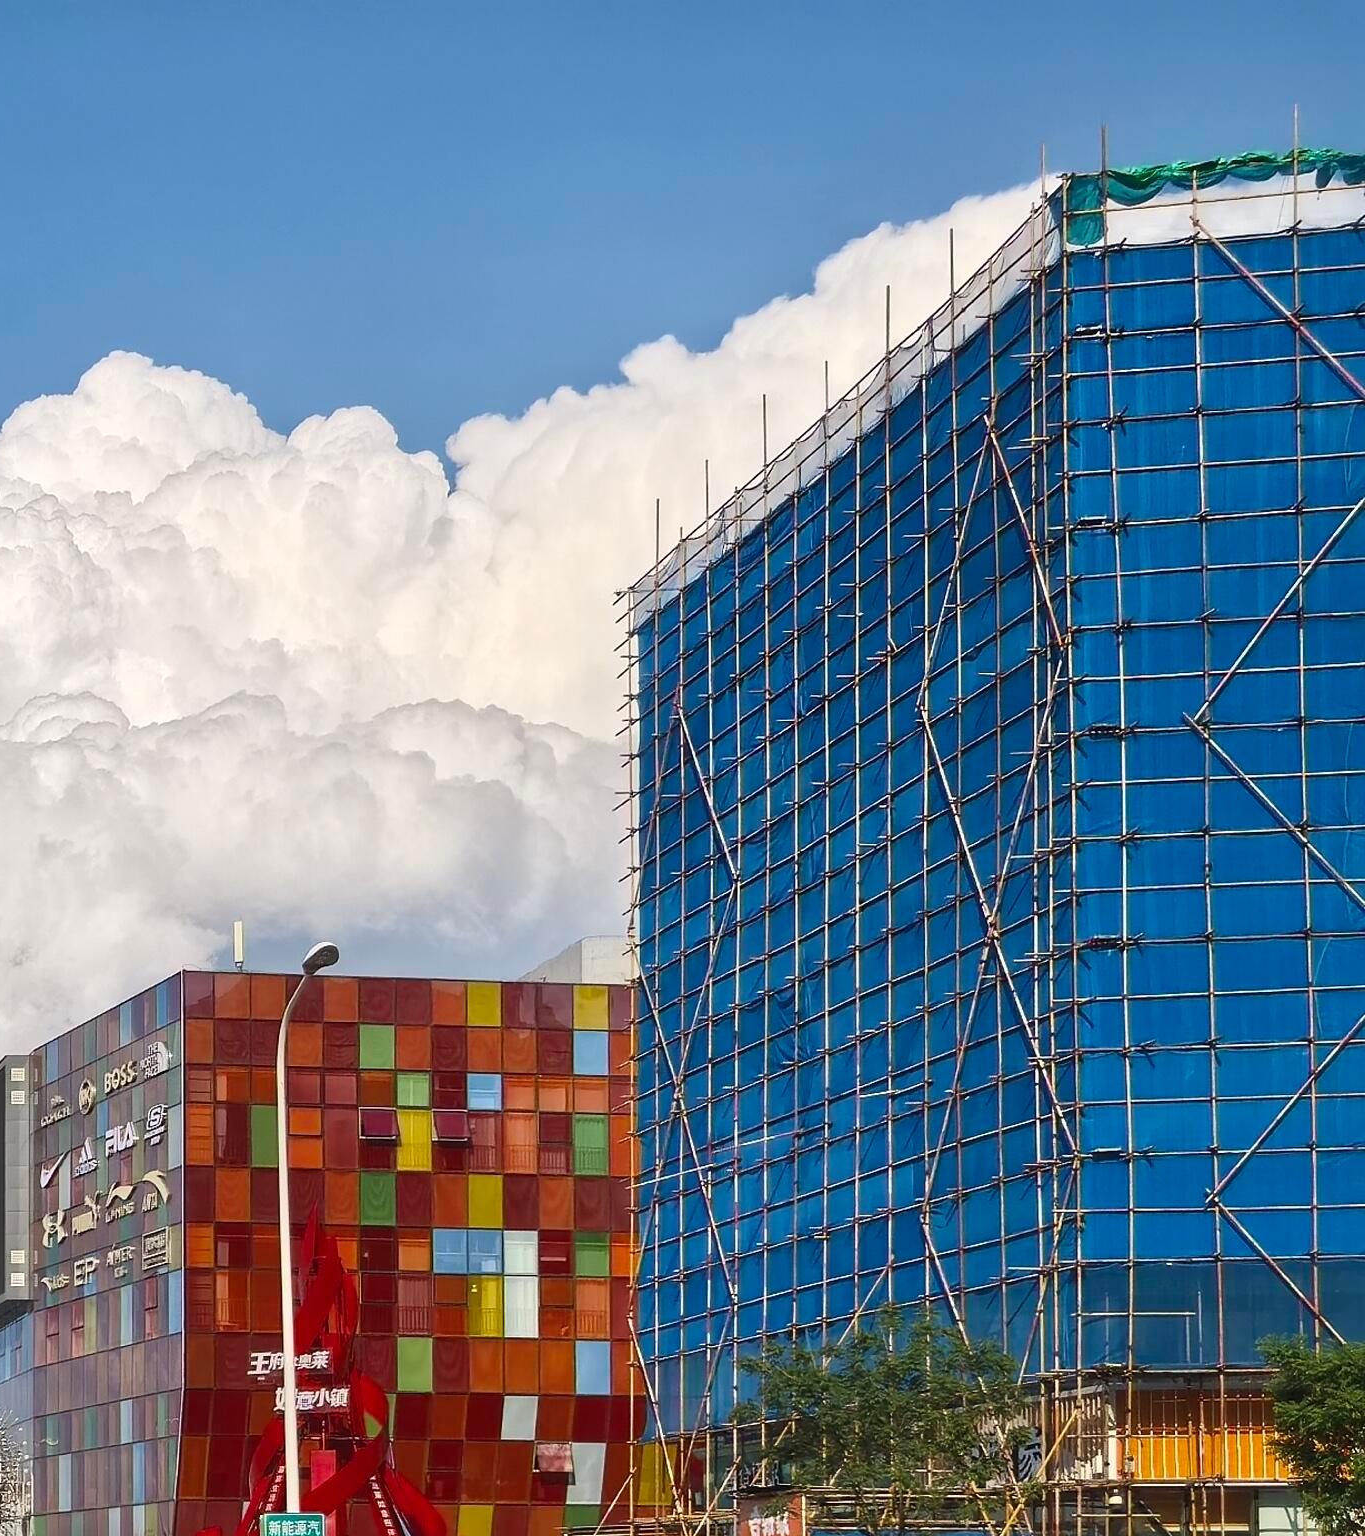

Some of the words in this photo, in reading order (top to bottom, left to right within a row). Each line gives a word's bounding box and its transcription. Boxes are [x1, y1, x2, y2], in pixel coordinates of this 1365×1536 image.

[104, 1061, 136, 1095] BOSS
[105, 1121, 137, 1157] FILA
[247, 1350, 330, 1375] 王府奥莱
[268, 1520, 321, 1536] 新能源汽
